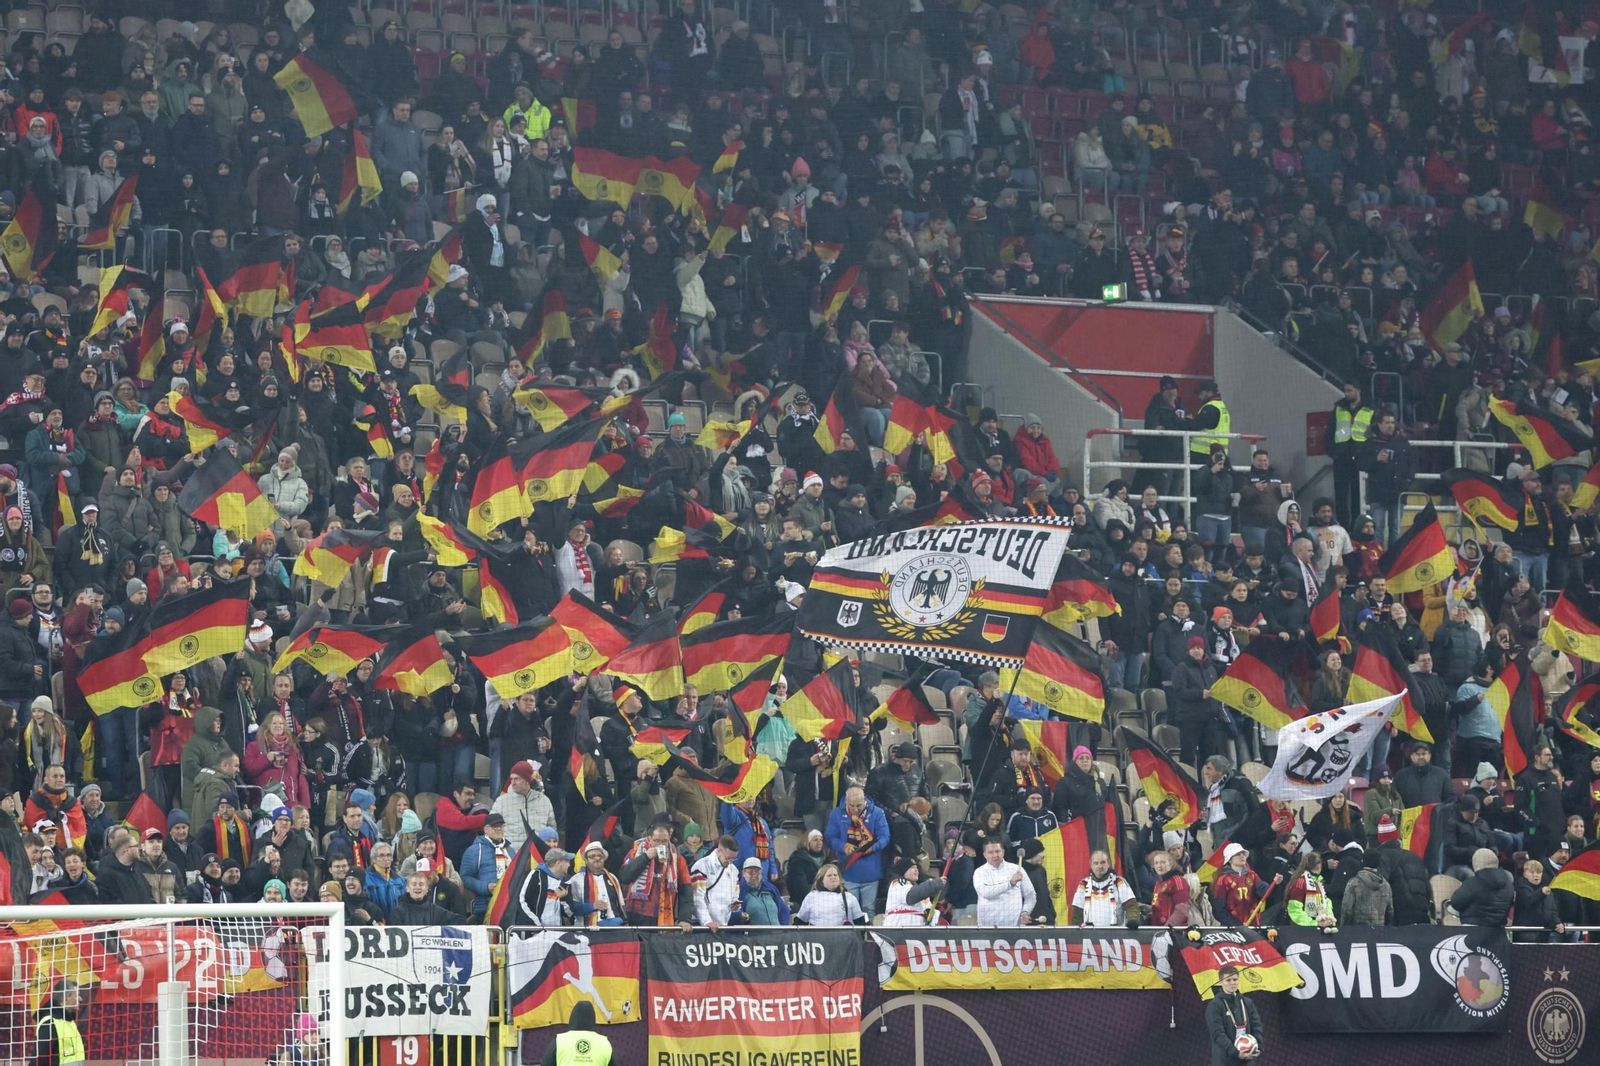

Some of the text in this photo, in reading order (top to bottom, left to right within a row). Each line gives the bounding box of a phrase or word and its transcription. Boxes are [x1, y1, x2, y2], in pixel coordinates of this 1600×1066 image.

[432, 939, 464, 947] WOHLEN
[685, 942, 825, 967] SUPPORT UND
[906, 938, 1142, 974] DEUTSCHLAND
[1212, 946, 1263, 966] LEIPZIG
[424, 966, 442, 974] 1904
[1285, 942, 1421, 1000] SMD
[653, 993, 861, 1022] FANVERTRETER DER
[1453, 992, 1483, 1017] SEKTION
[1540, 997, 1573, 1012] DEUTSCHER
[391, 1036, 418, 1065] 19
